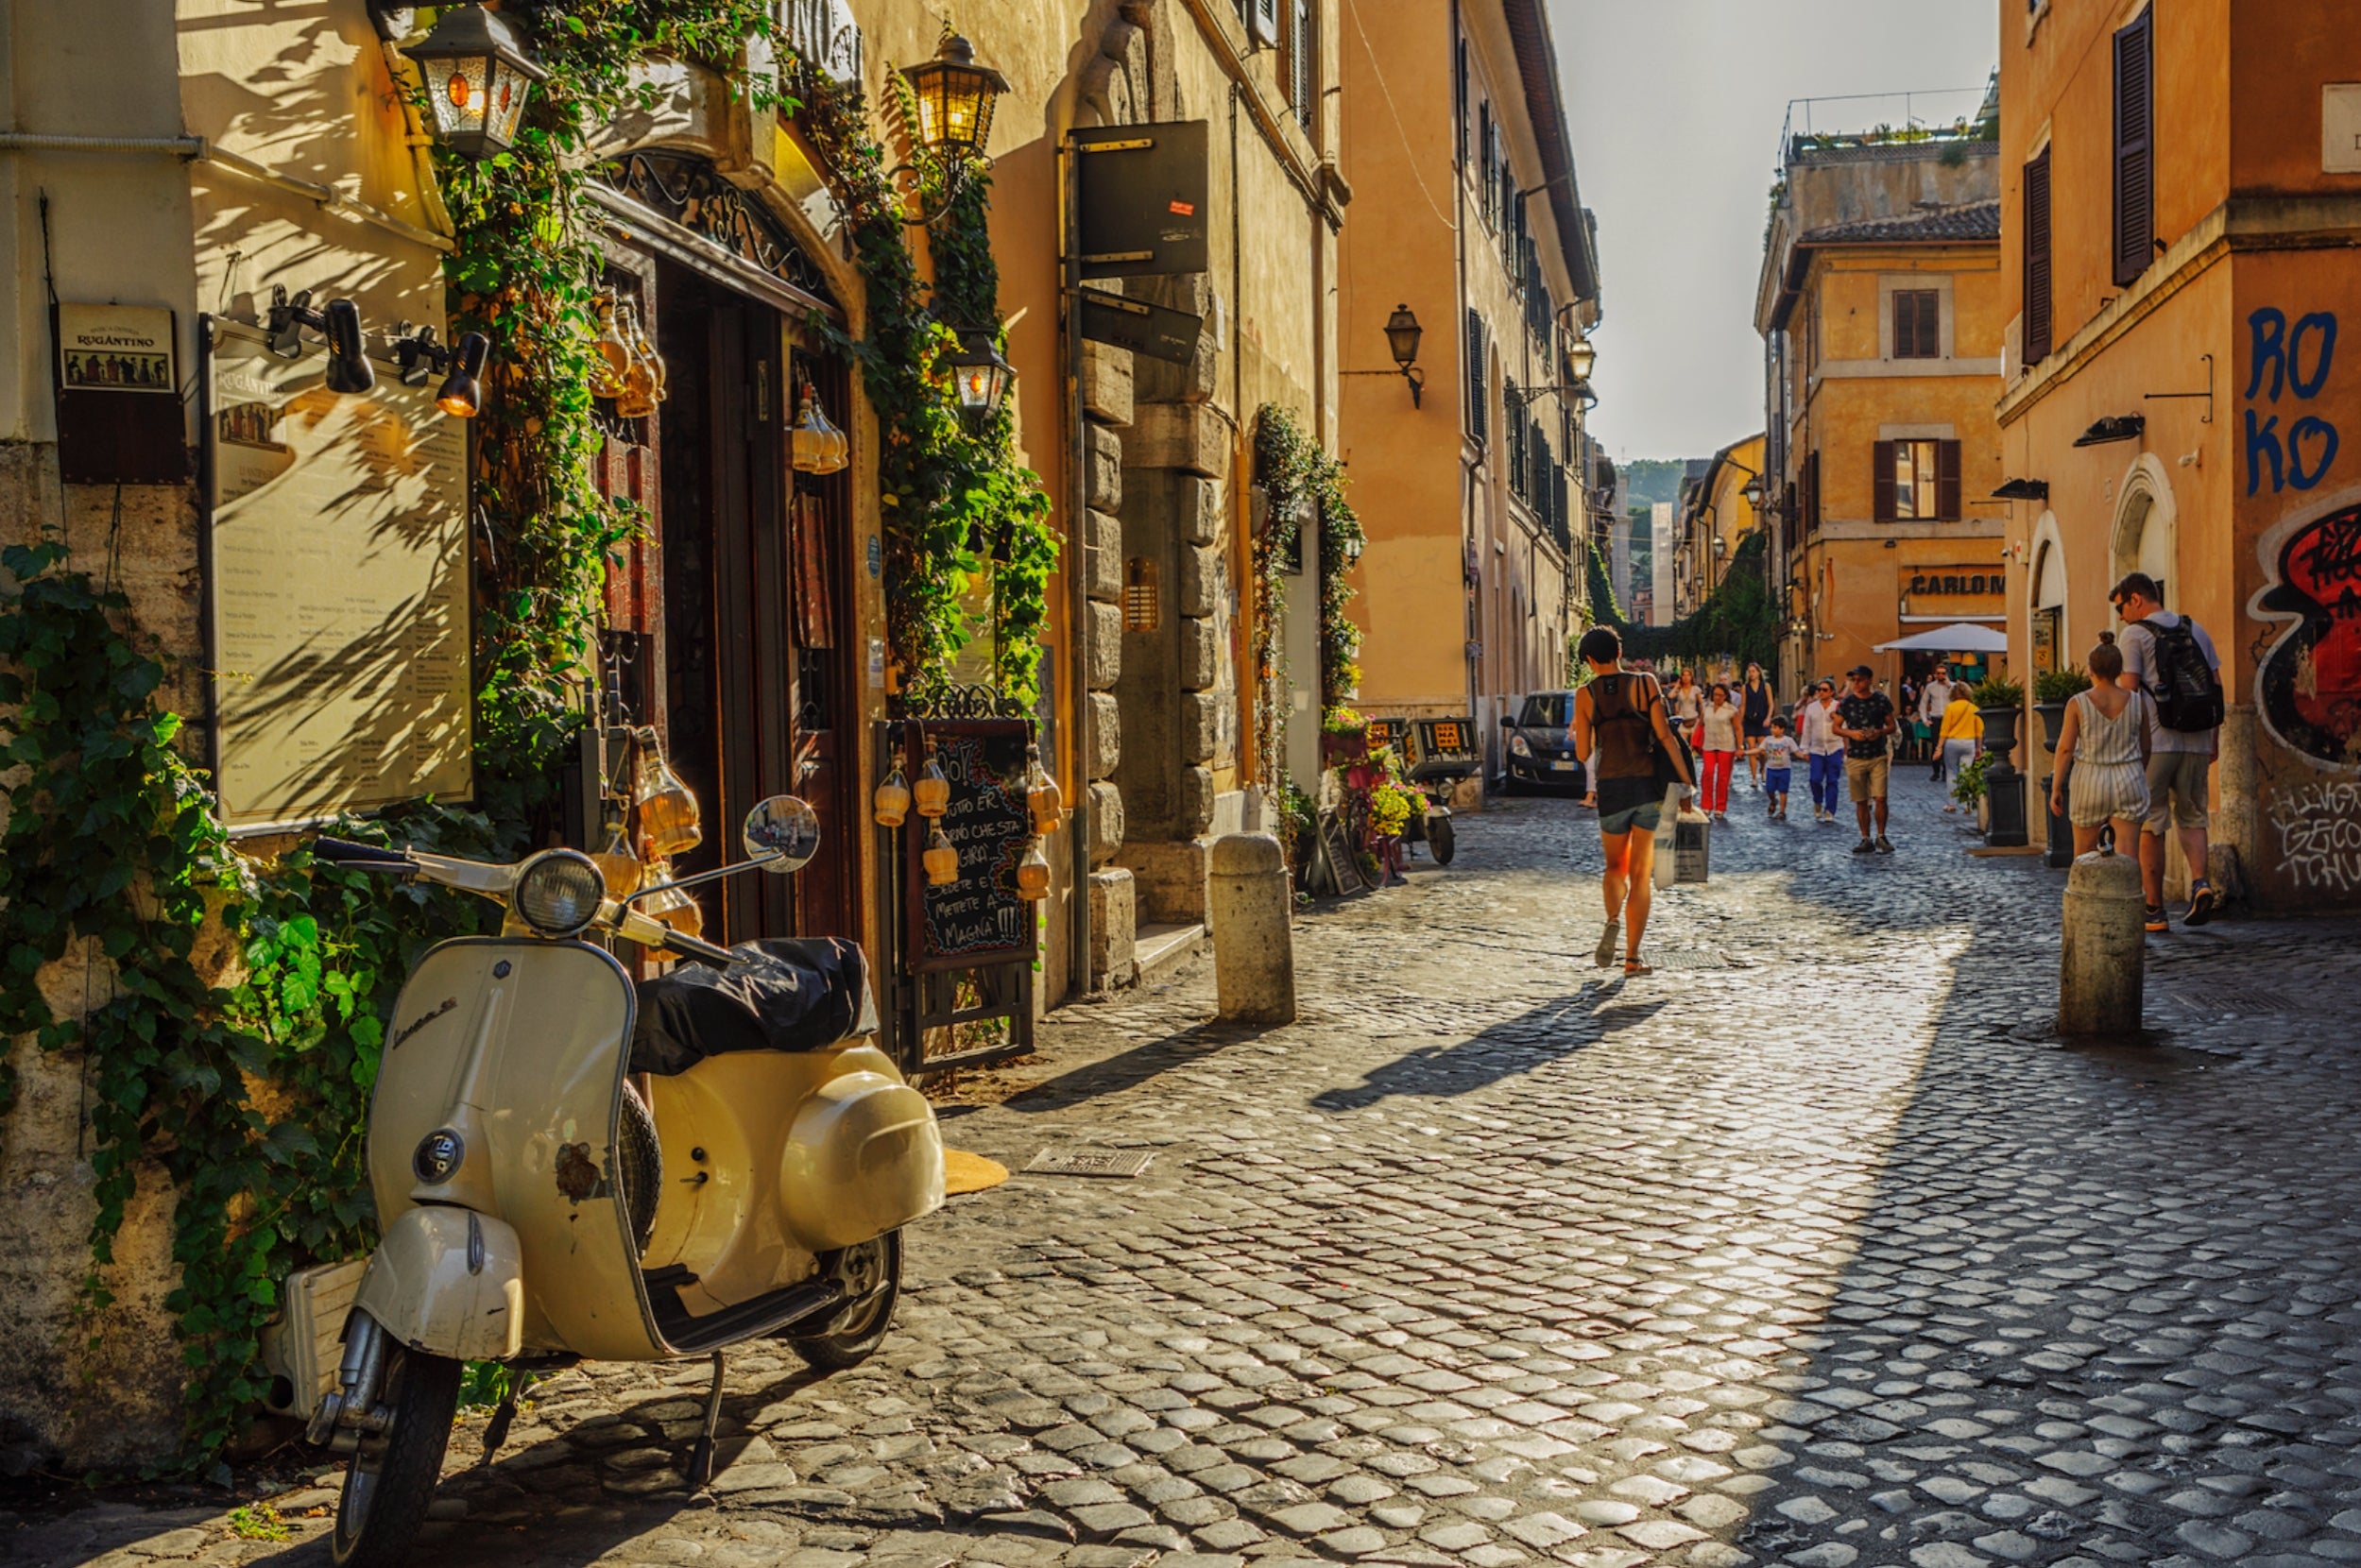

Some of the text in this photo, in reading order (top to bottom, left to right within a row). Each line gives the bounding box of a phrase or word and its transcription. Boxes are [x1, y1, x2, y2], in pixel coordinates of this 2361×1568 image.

[77, 334, 155, 348] RUGANTINO
[2244, 307, 2337, 403] RO
[2244, 408, 2339, 498] KO
[1911, 573, 1985, 595] CARLO
[977, 792, 1000, 812] ER
[979, 877, 988, 888] E
[986, 894, 999, 909] A
